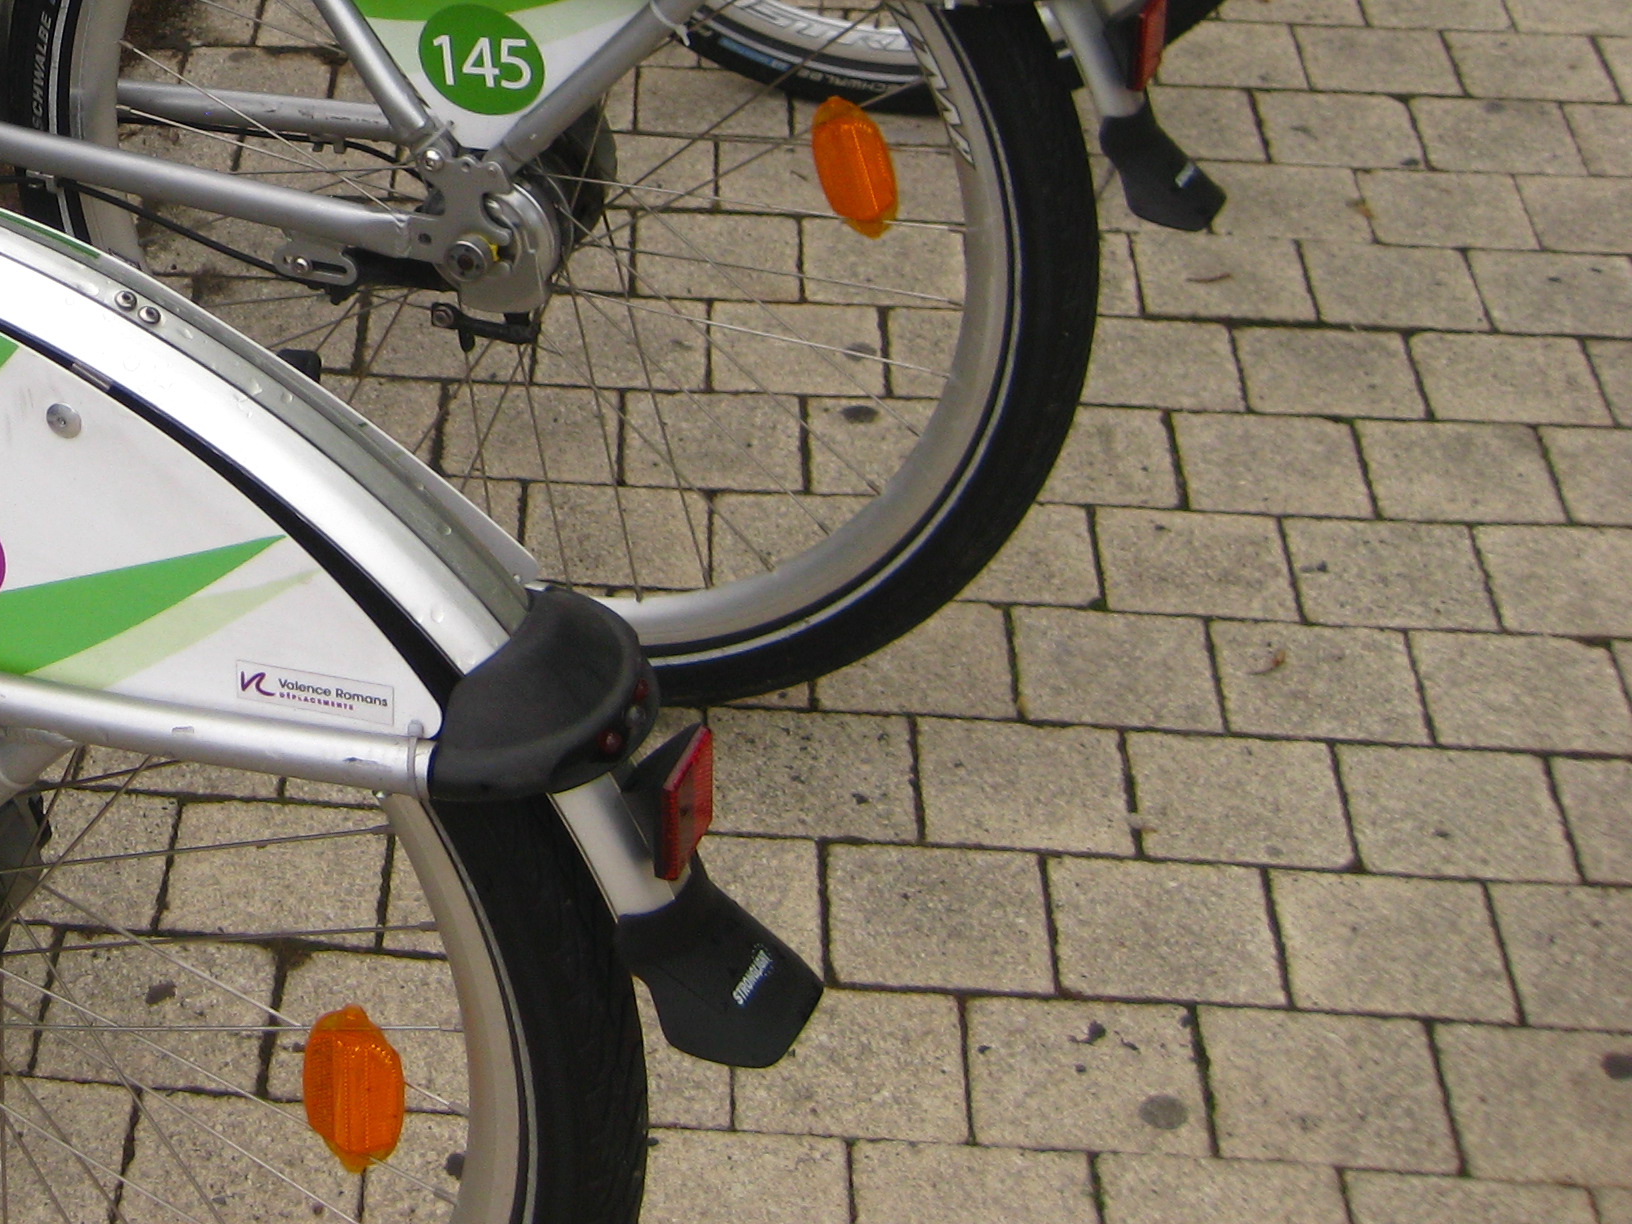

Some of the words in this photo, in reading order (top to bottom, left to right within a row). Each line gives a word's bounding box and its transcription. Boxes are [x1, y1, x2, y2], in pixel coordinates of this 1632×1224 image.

[32, 10, 52, 131] SCHWALBE
[431, 33, 532, 95] 145
[278, 677, 332, 697] Valence
[335, 687, 389, 708] Romans
[279, 691, 354, 711] DÉPLACEMENTS
